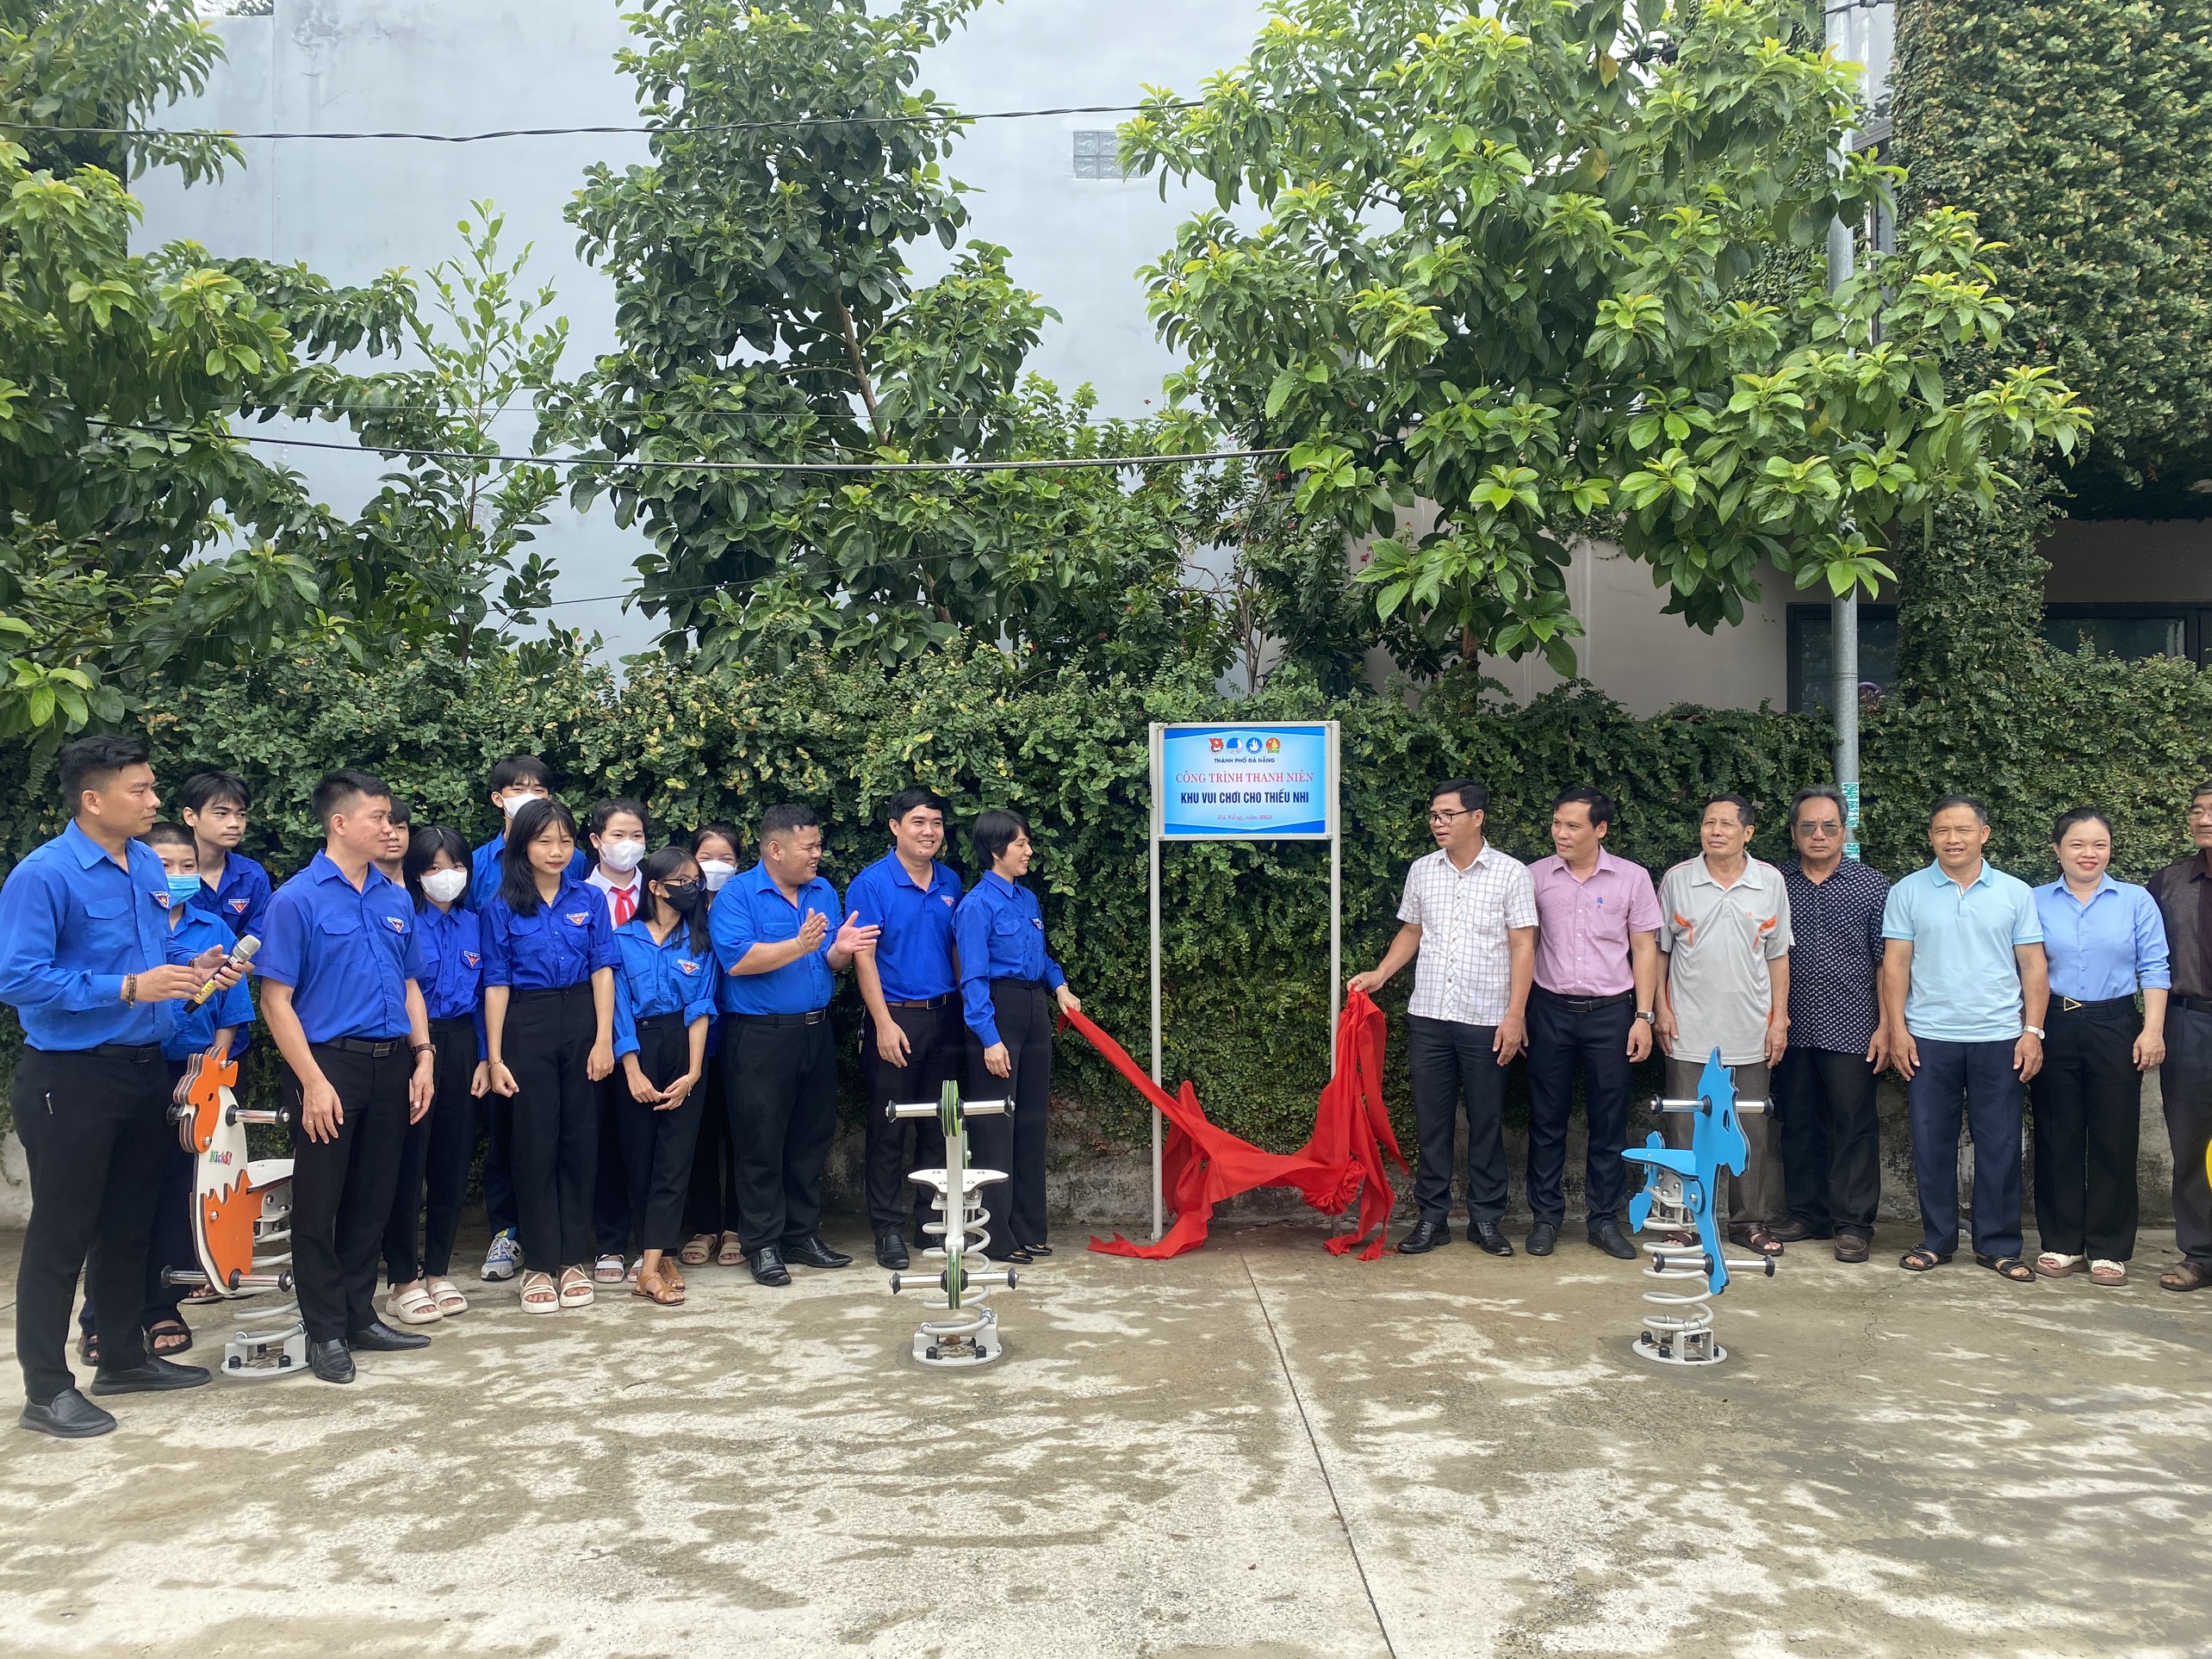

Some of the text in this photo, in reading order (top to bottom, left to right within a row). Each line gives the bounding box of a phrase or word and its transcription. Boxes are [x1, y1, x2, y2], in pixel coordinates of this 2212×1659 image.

[1176, 769, 1314, 783] CÔNG TRÌNH THANH NIÊN
[1181, 787, 1309, 804] KHU VUI CHƠI CHO THIẾU NHI
